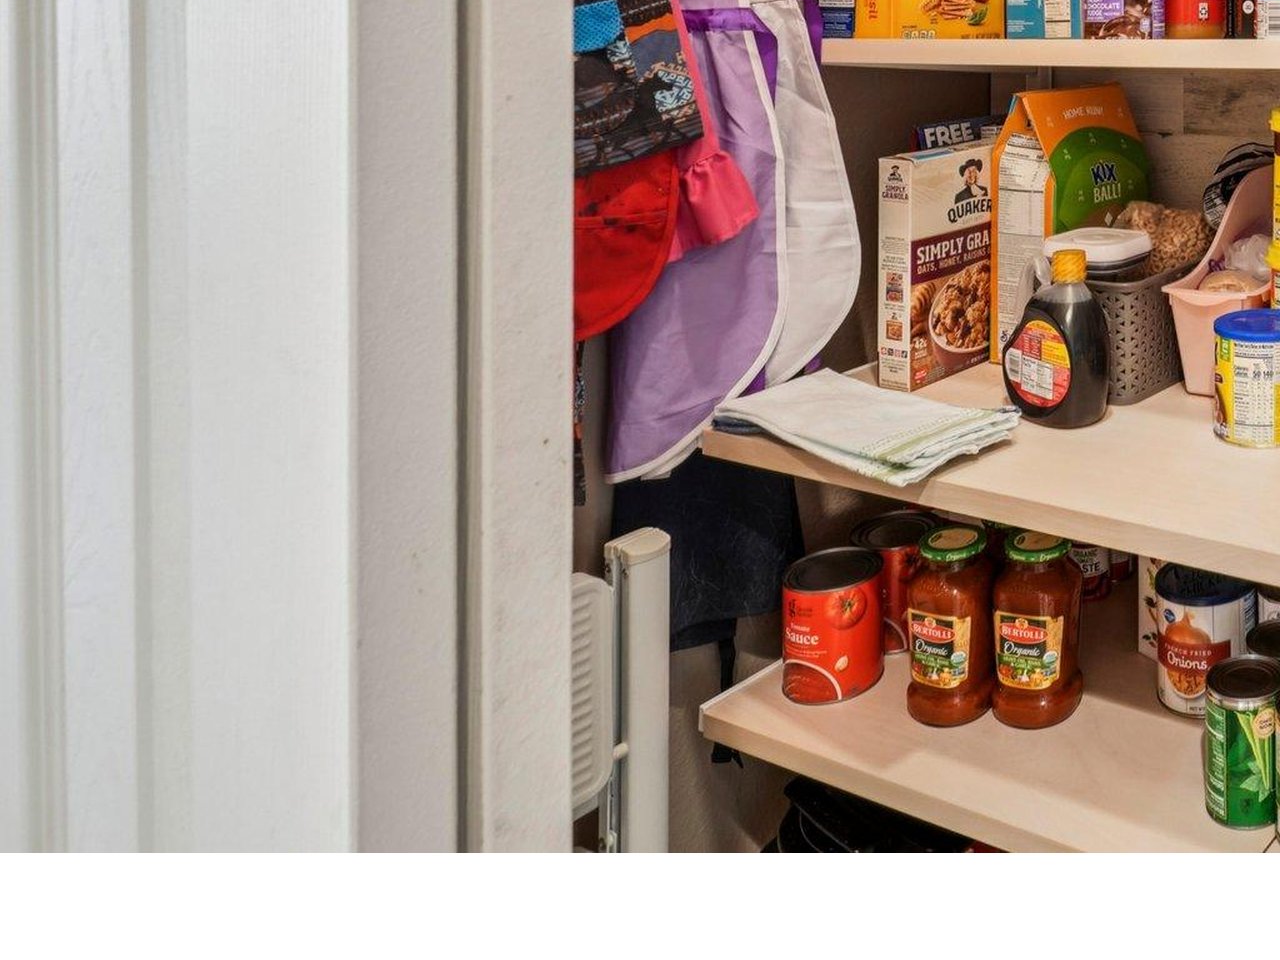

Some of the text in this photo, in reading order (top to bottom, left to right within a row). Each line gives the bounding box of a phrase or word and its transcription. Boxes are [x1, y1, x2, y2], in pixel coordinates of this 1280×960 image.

[1063, 107, 1085, 120] HOME
[924, 121, 975, 149] FREE
[1090, 160, 1119, 185] KIX
[1093, 183, 1121, 204] BALL!
[948, 198, 992, 224] QUAKER
[917, 237, 964, 265] SIMPLY
[963, 247, 987, 262] RAISINS
[785, 627, 819, 645] Sauce
[913, 623, 952, 639] BERTOLLI
[1001, 625, 1043, 640] BERTOLLI
[915, 639, 948, 657] Organic
[1003, 641, 1040, 657] Organic
[1167, 651, 1208, 670] Onions
